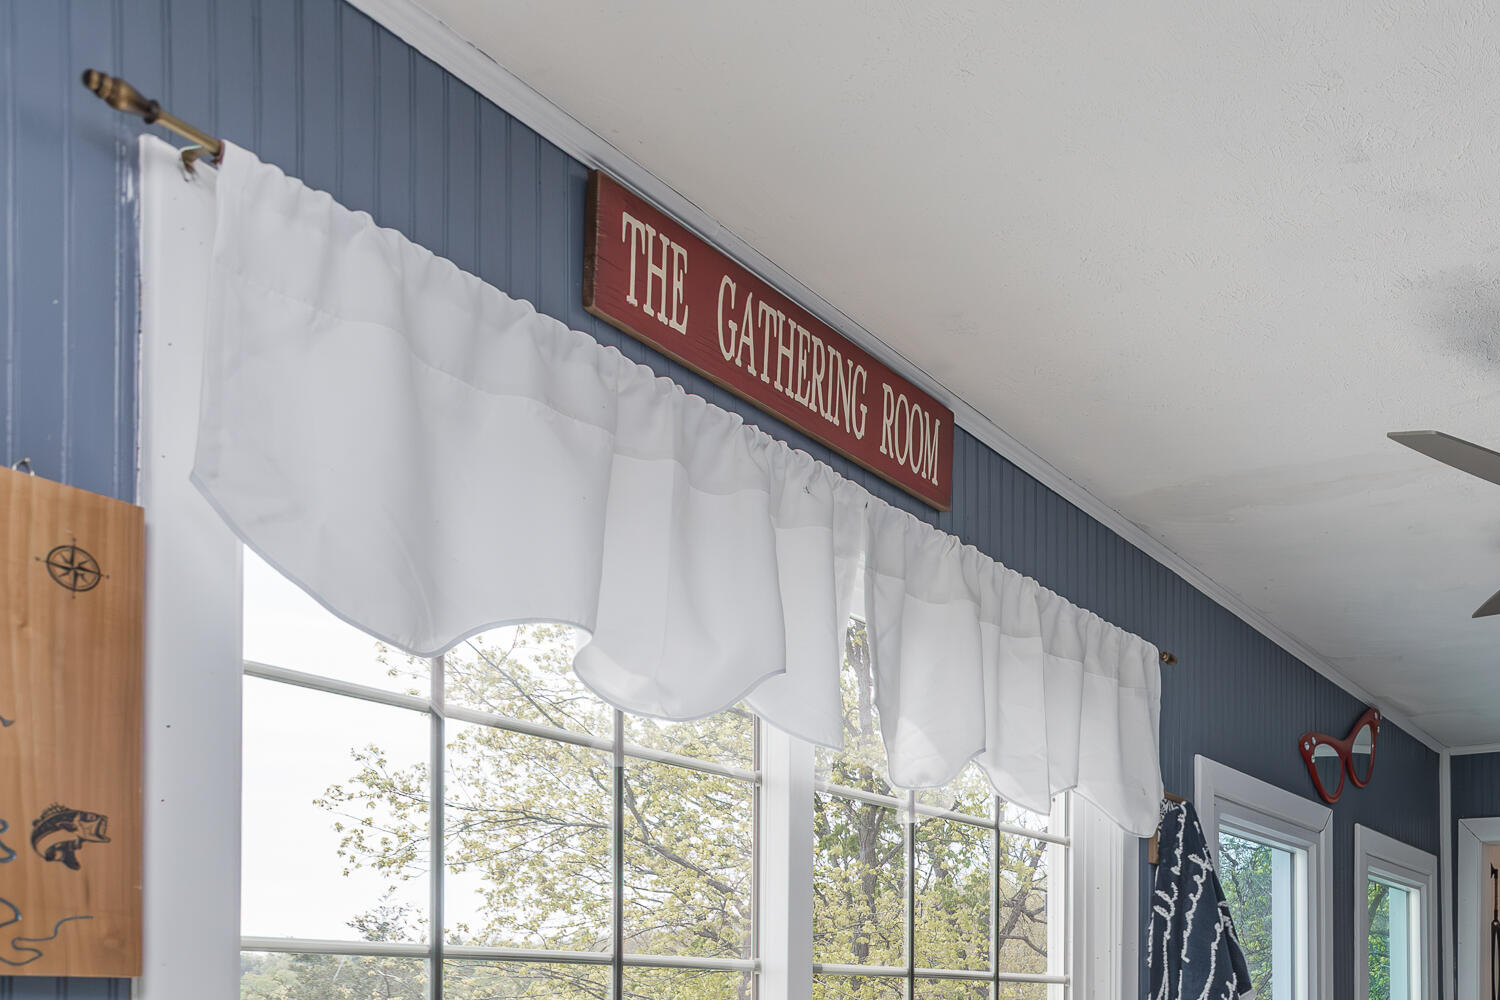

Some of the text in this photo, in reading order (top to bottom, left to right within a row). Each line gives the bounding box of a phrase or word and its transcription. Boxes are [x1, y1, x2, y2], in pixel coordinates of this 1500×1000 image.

[622, 211, 941, 486] THE GATHERING ROOM
